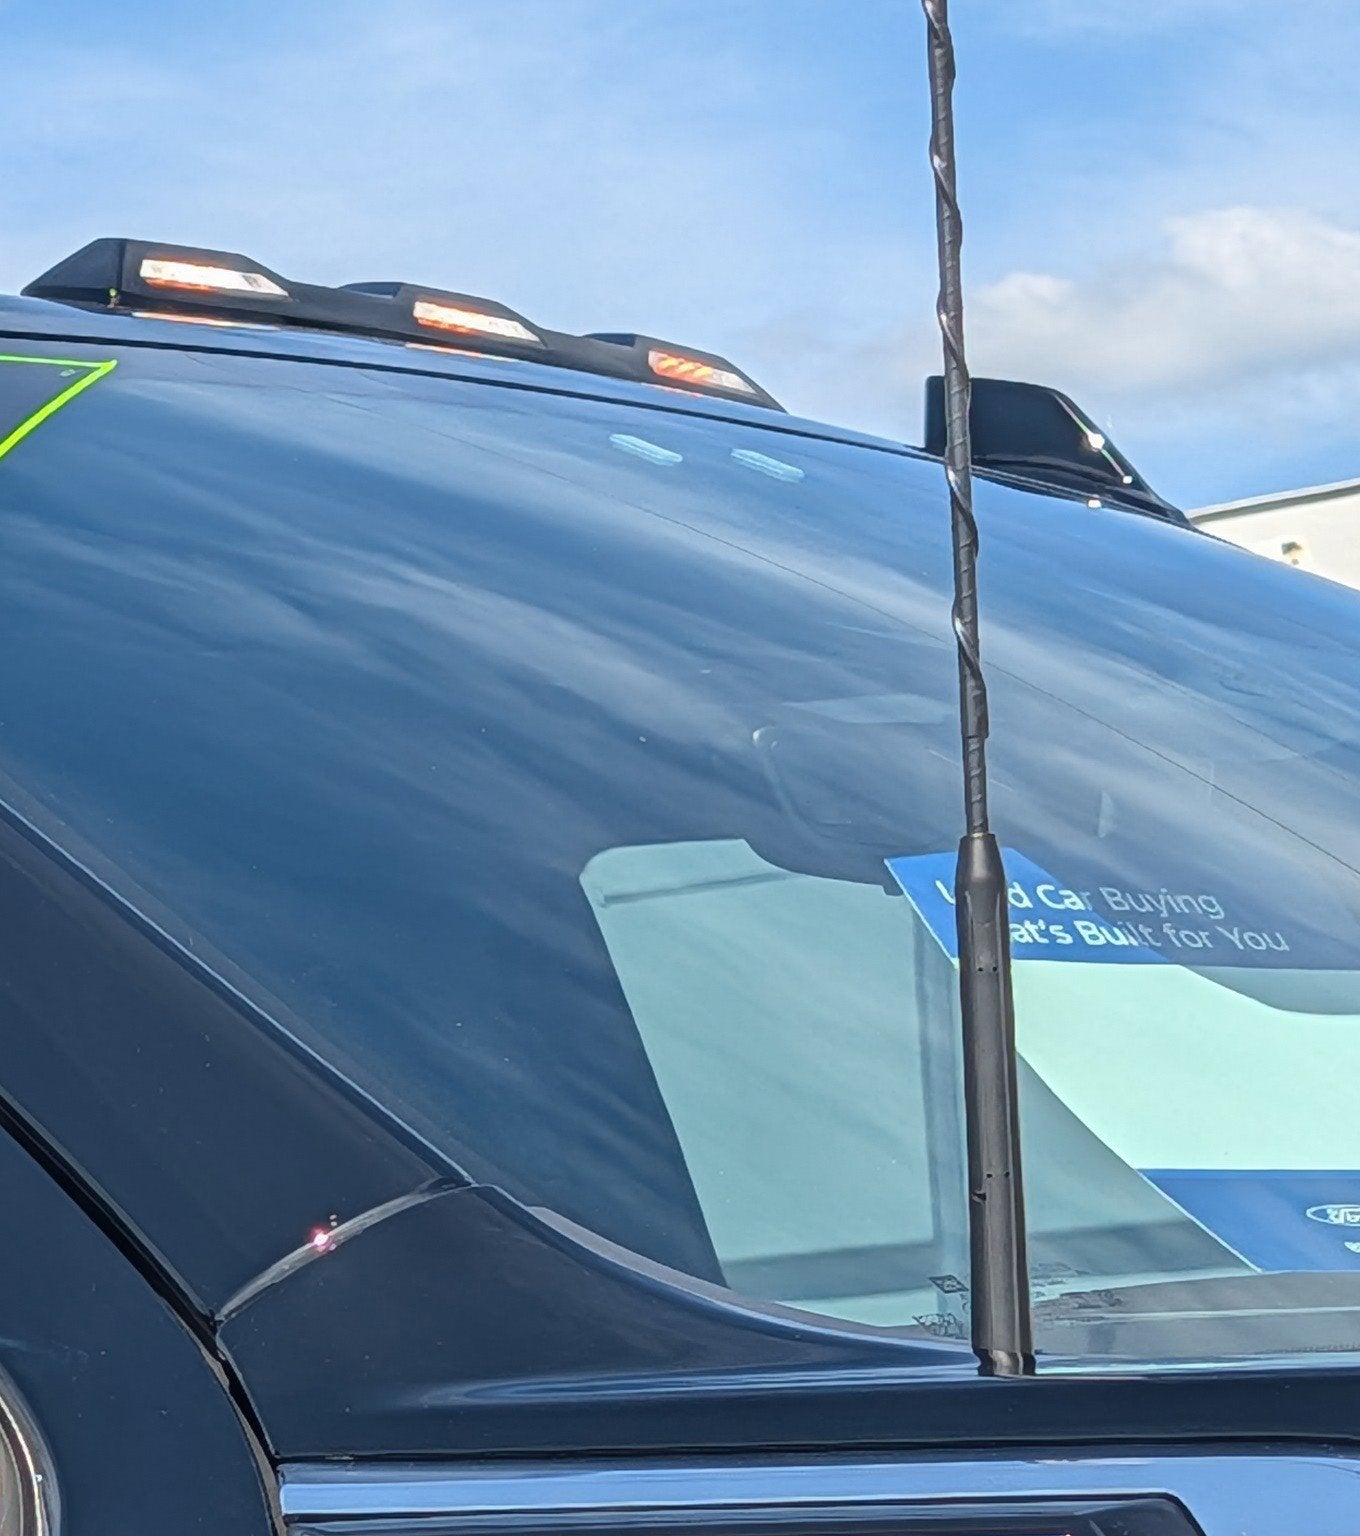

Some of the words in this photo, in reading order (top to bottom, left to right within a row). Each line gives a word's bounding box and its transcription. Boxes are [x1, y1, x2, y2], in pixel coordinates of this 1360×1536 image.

[1036, 885, 1093, 911] Car
[1099, 887, 1225, 919] Buying
[1009, 920, 1073, 945] at's
[1074, 920, 1161, 948] Built
[1163, 922, 1214, 949] for
[1216, 926, 1290, 951] You
